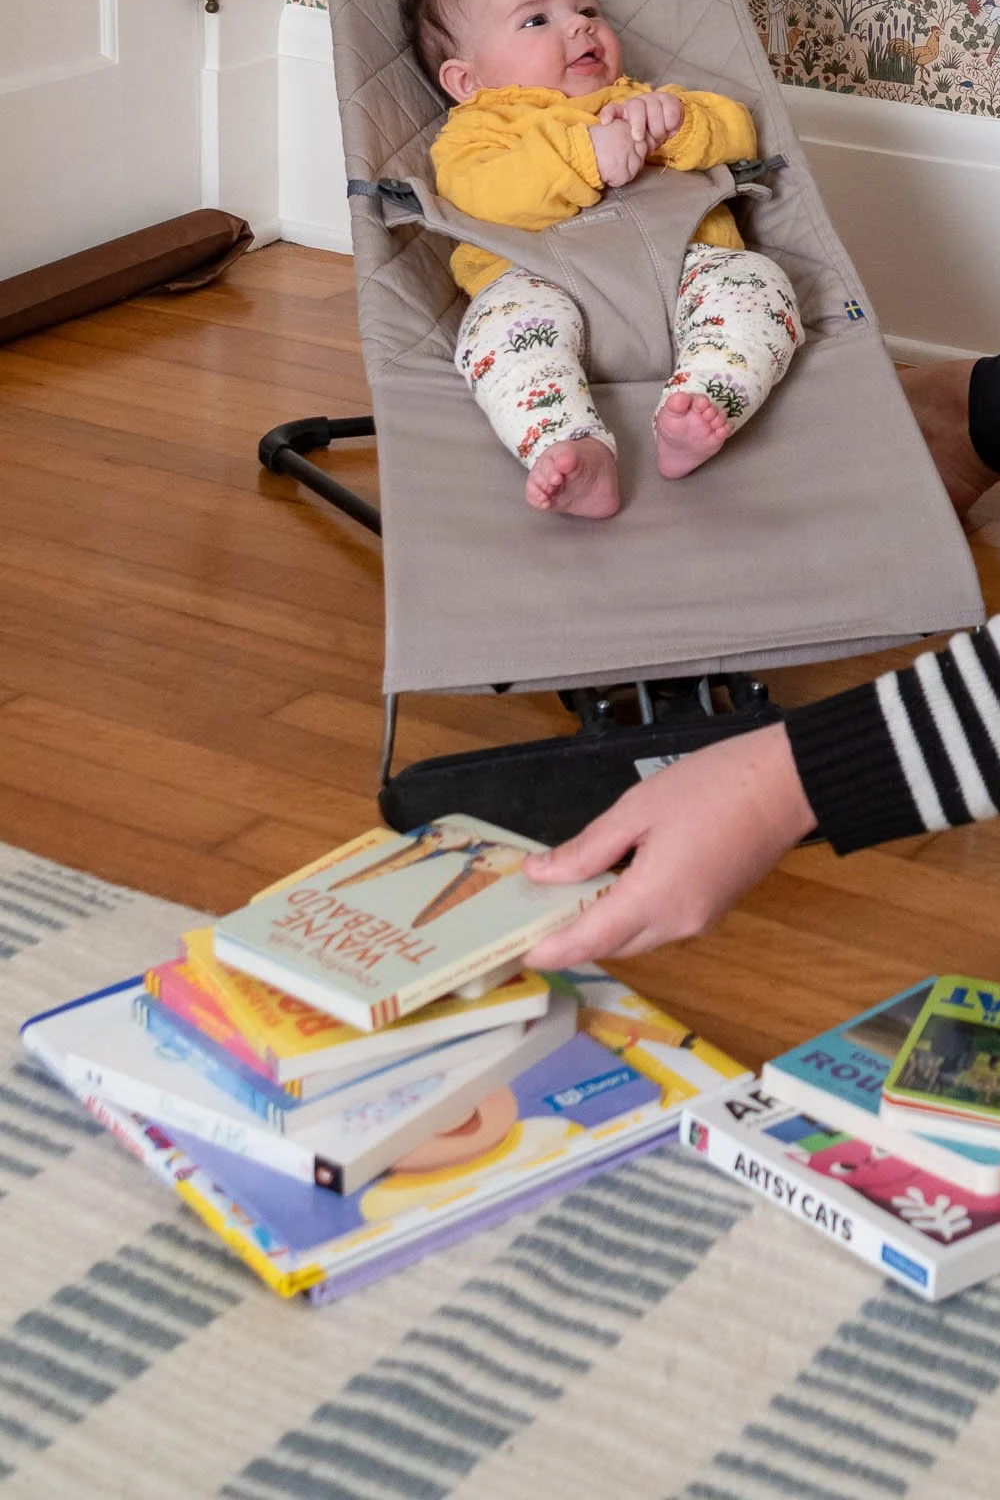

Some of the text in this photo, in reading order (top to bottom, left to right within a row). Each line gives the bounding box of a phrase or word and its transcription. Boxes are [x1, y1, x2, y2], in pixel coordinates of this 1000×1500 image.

[271, 909, 386, 970] WAYNE
[287, 887, 438, 965] THIEBAUD
[734, 1153, 853, 1241] ARTSY CATS
